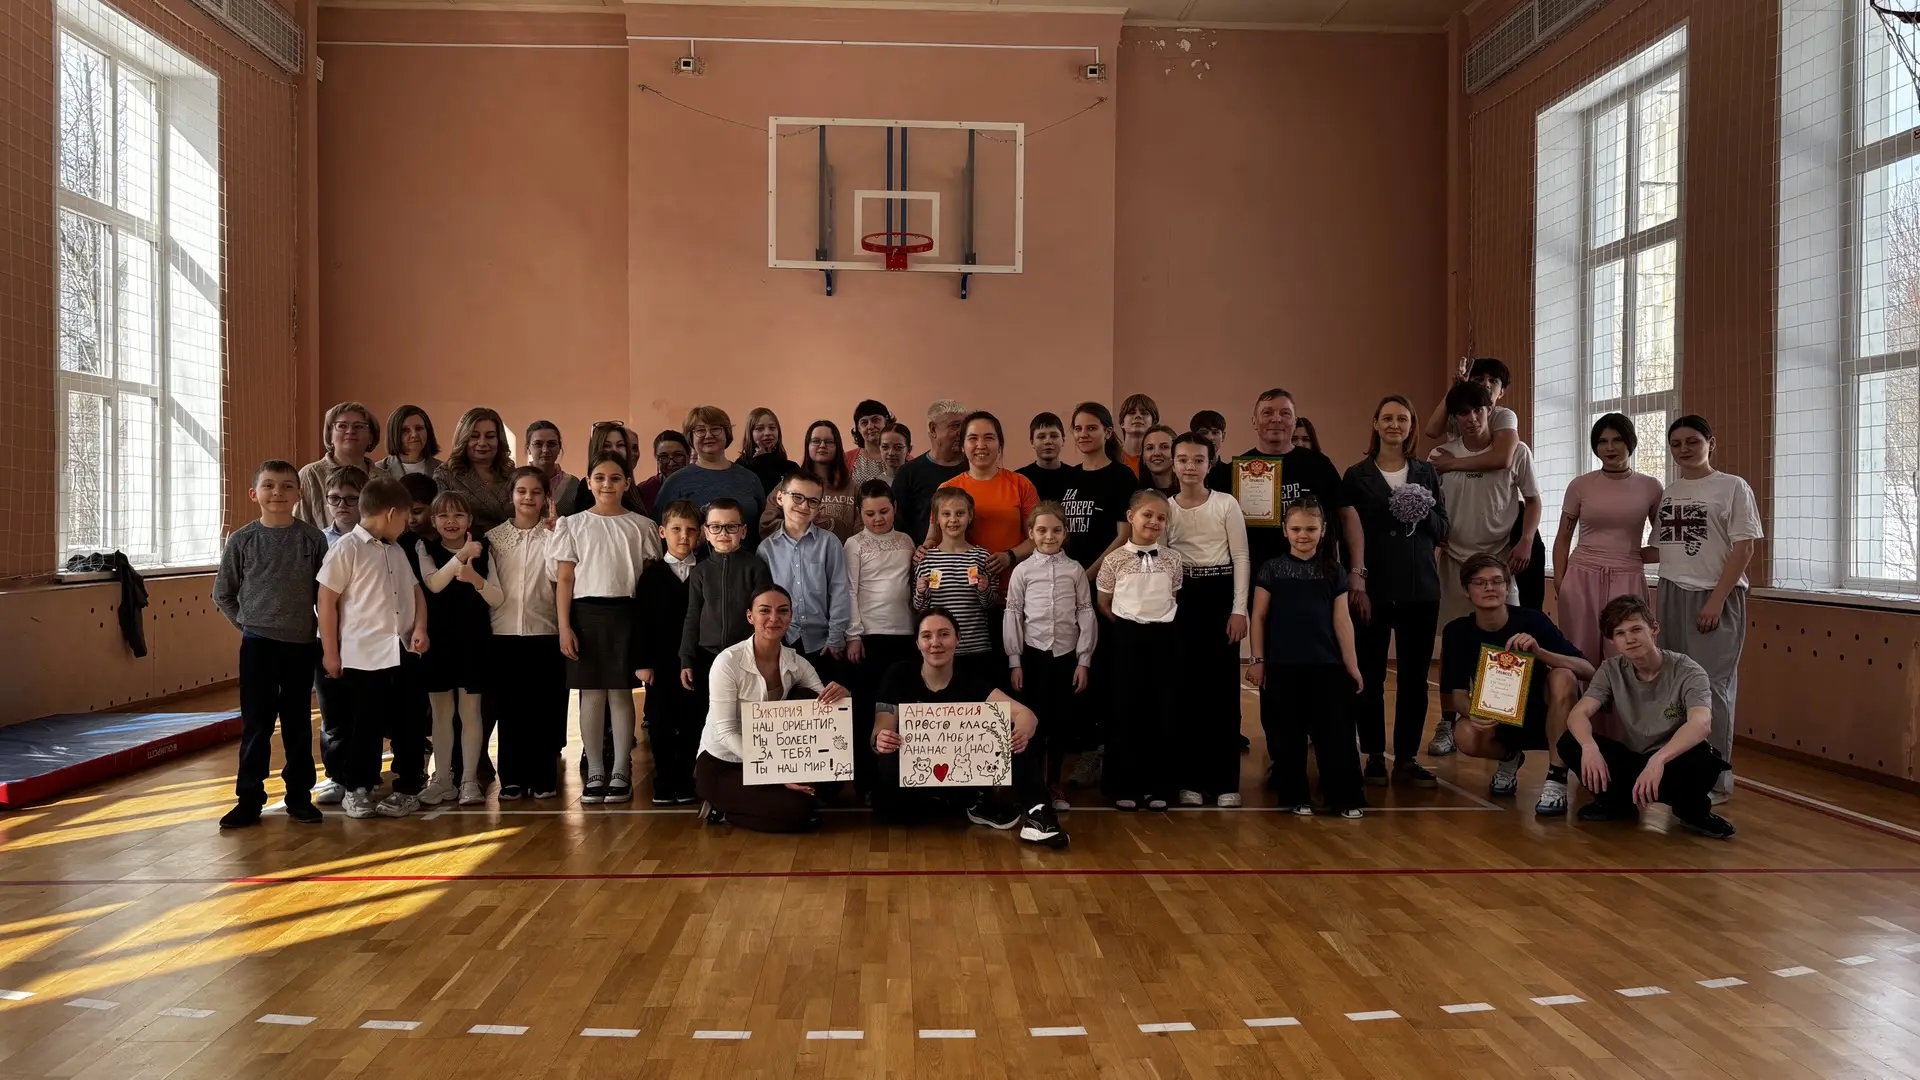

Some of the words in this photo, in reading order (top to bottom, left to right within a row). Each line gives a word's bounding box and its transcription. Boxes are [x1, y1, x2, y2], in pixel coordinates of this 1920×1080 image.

[1062, 488, 1078, 501] НА
[752, 703, 803, 719] ВИКТОРИЯ
[812, 701, 833, 716] РАФ
[904, 705, 982, 717] АНАСТАСИЯ
[752, 722, 774, 733] НАШ
[782, 717, 837, 732] ОРИЕНТИР,
[905, 719, 951, 730] ПРОСТО
[960, 720, 997, 730] КЛАСС
[776, 731, 817, 746] БОЛЕЕМ
[905, 733, 930, 743] ОНА
[937, 732, 987, 742] ЛЮБИТ
[758, 746, 774, 760] ЗА
[780, 746, 812, 759] ТЕБЯ
[904, 744, 947, 755] АНАНАС
[954, 745, 962, 754] И
[964, 740, 994, 754] (НАС)
[777, 763, 798, 773] НАШ
